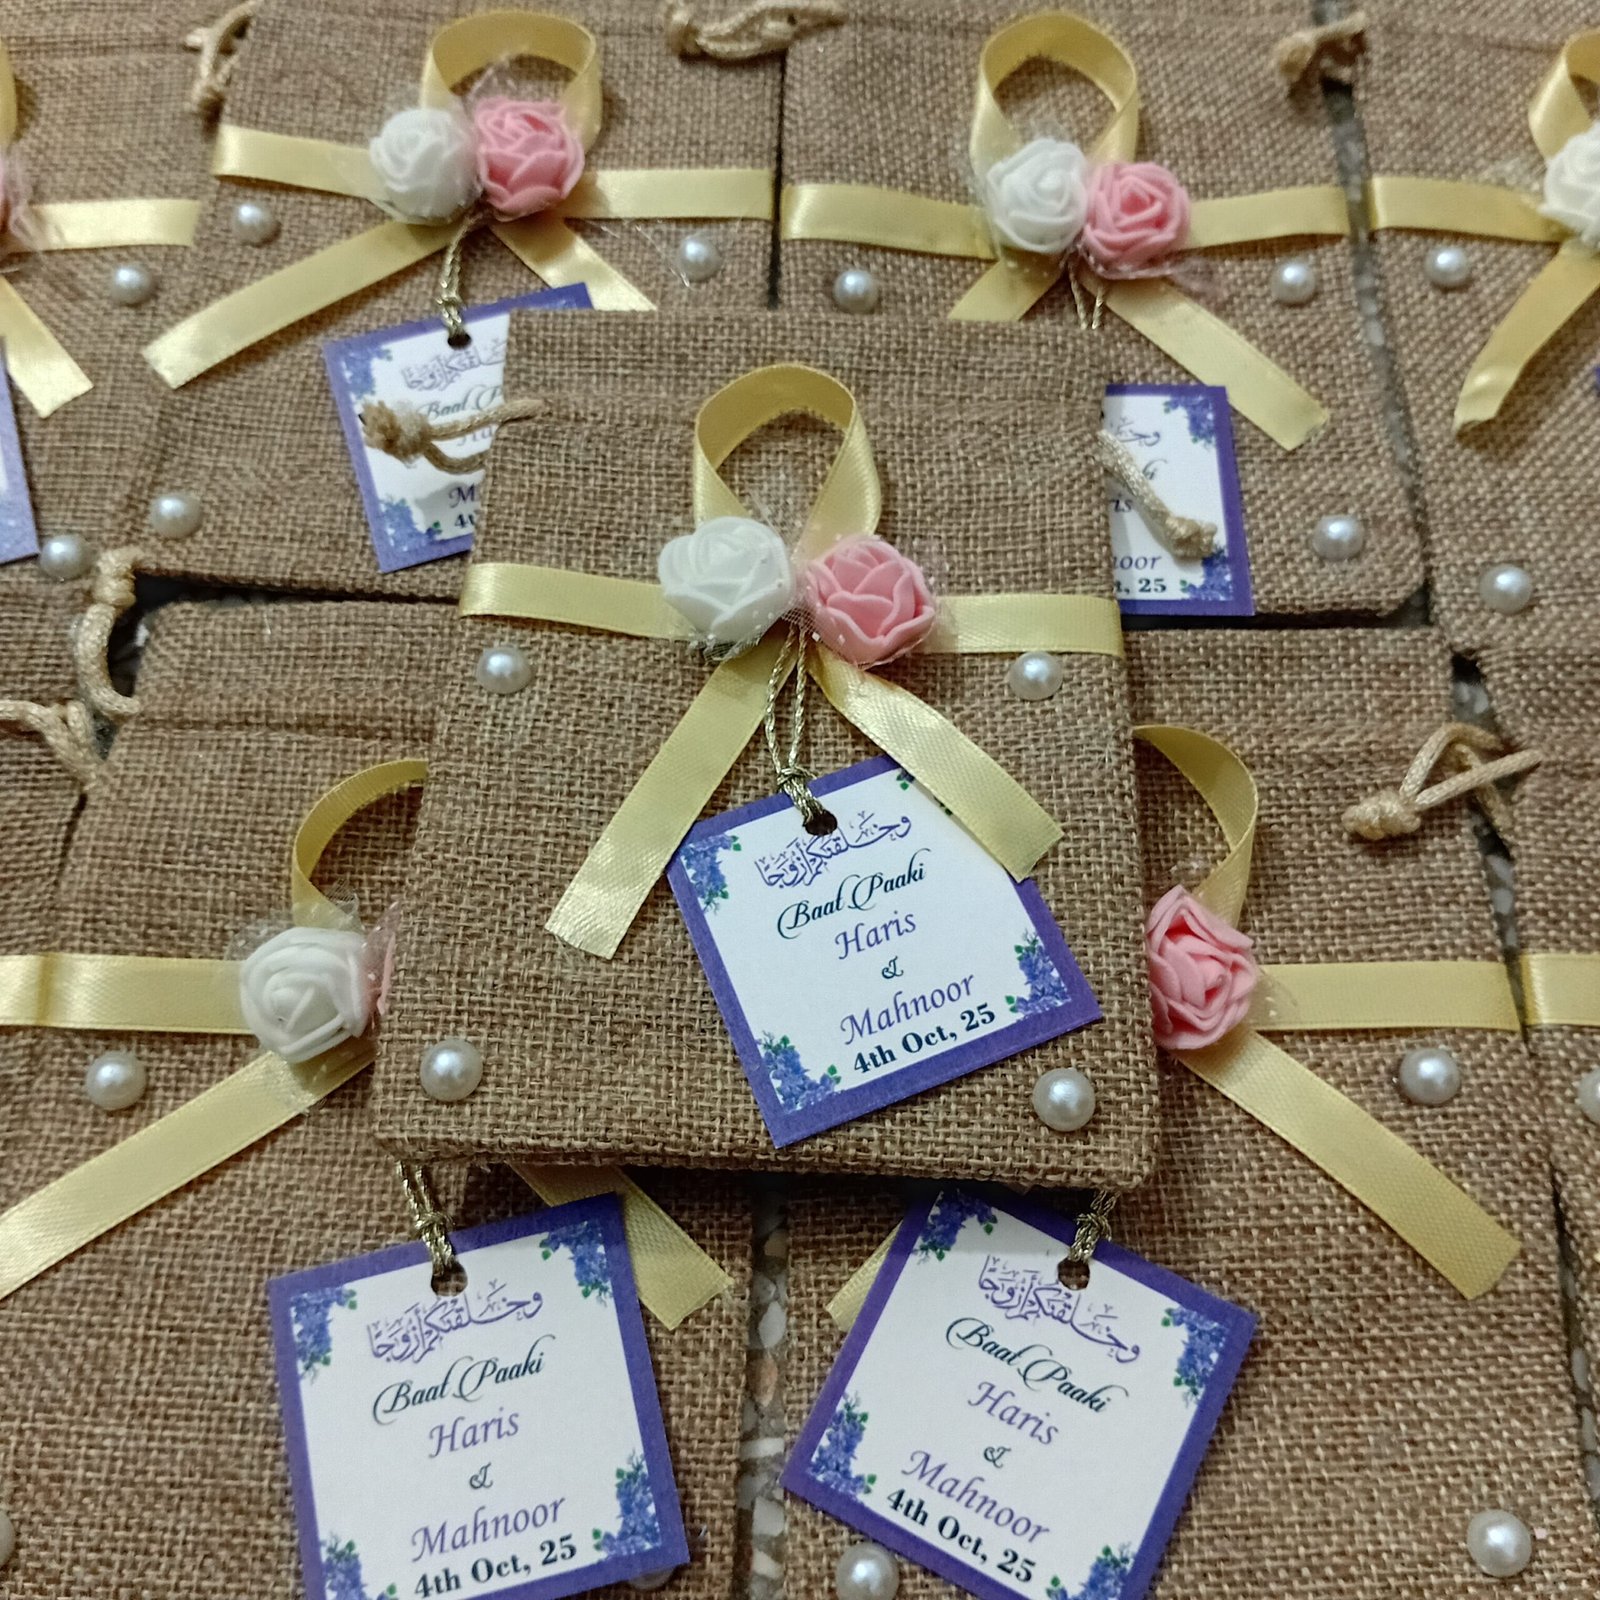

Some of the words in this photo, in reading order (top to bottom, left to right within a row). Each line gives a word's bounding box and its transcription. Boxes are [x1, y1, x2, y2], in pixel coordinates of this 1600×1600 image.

[416, 384, 487, 420] Baal
[1138, 578, 1167, 593] 25
[778, 874, 858, 939] Baal
[848, 848, 931, 910] Paaki
[835, 910, 916, 959] Haris
[881, 956, 904, 980] &
[840, 974, 974, 1045] Mahnoor
[854, 1045, 896, 1074] 4th
[901, 1025, 957, 1053] Oct,
[960, 1002, 996, 1032] 25
[373, 1355, 473, 1425] Baal
[452, 1334, 556, 1402] Paaki
[946, 1317, 1053, 1367] Baal
[1017, 1358, 1129, 1413] Paaki
[429, 1406, 519, 1458] Haris
[968, 1381, 1059, 1445] Haris
[469, 1463, 493, 1490] &
[983, 1446, 1011, 1468] &
[901, 1450, 1049, 1544] Mahnoor
[411, 1498, 566, 1562] Mahnoor
[887, 1488, 928, 1526] 4th
[937, 1515, 988, 1565] Oct,
[997, 1548, 1036, 1584] 25
[415, 1567, 461, 1598] 4th
[471, 1553, 532, 1583] Oct,
[539, 1534, 577, 1565] 25
